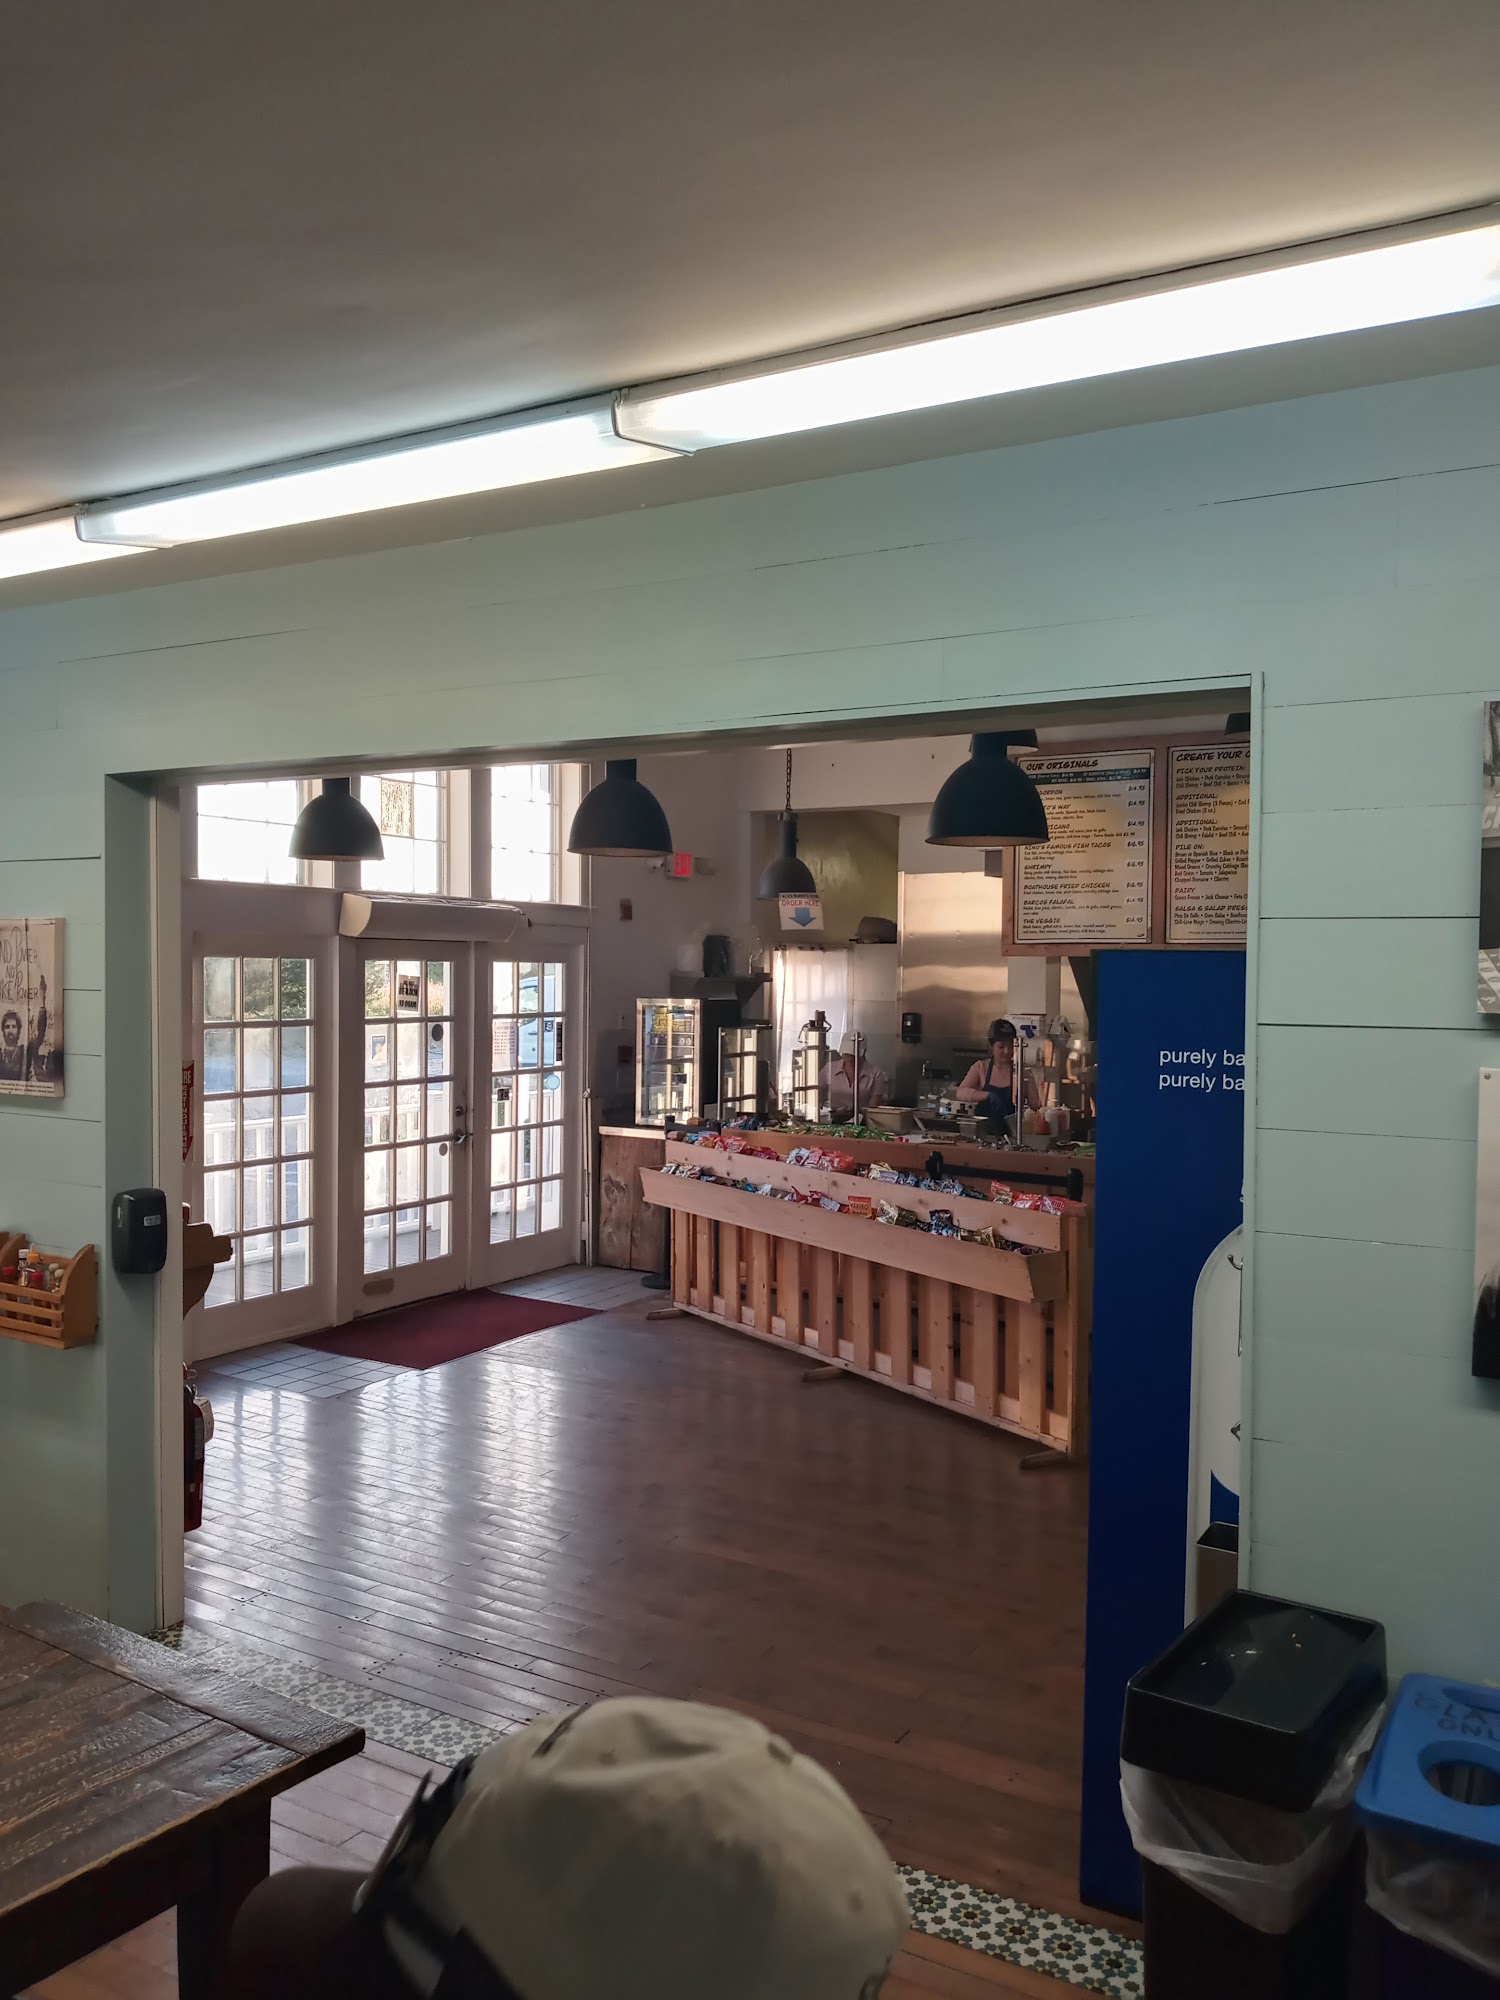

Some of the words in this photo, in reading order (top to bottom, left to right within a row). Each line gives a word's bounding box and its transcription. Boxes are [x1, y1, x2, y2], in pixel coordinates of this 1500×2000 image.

[1026, 762, 1044, 771] OUR
[1046, 760, 1098, 770] ORIGINALS
[1176, 752, 1214, 761] CREATE
[1217, 751, 1242, 759] YOUR
[676, 854, 692, 875] EXIT
[0, 979, 13, 1001] KE
[1160, 1048, 1217, 1068] purely
[1223, 1049, 1245, 1066] ba
[1159, 1073, 1216, 1093] purely
[1222, 1074, 1245, 1091] ba
